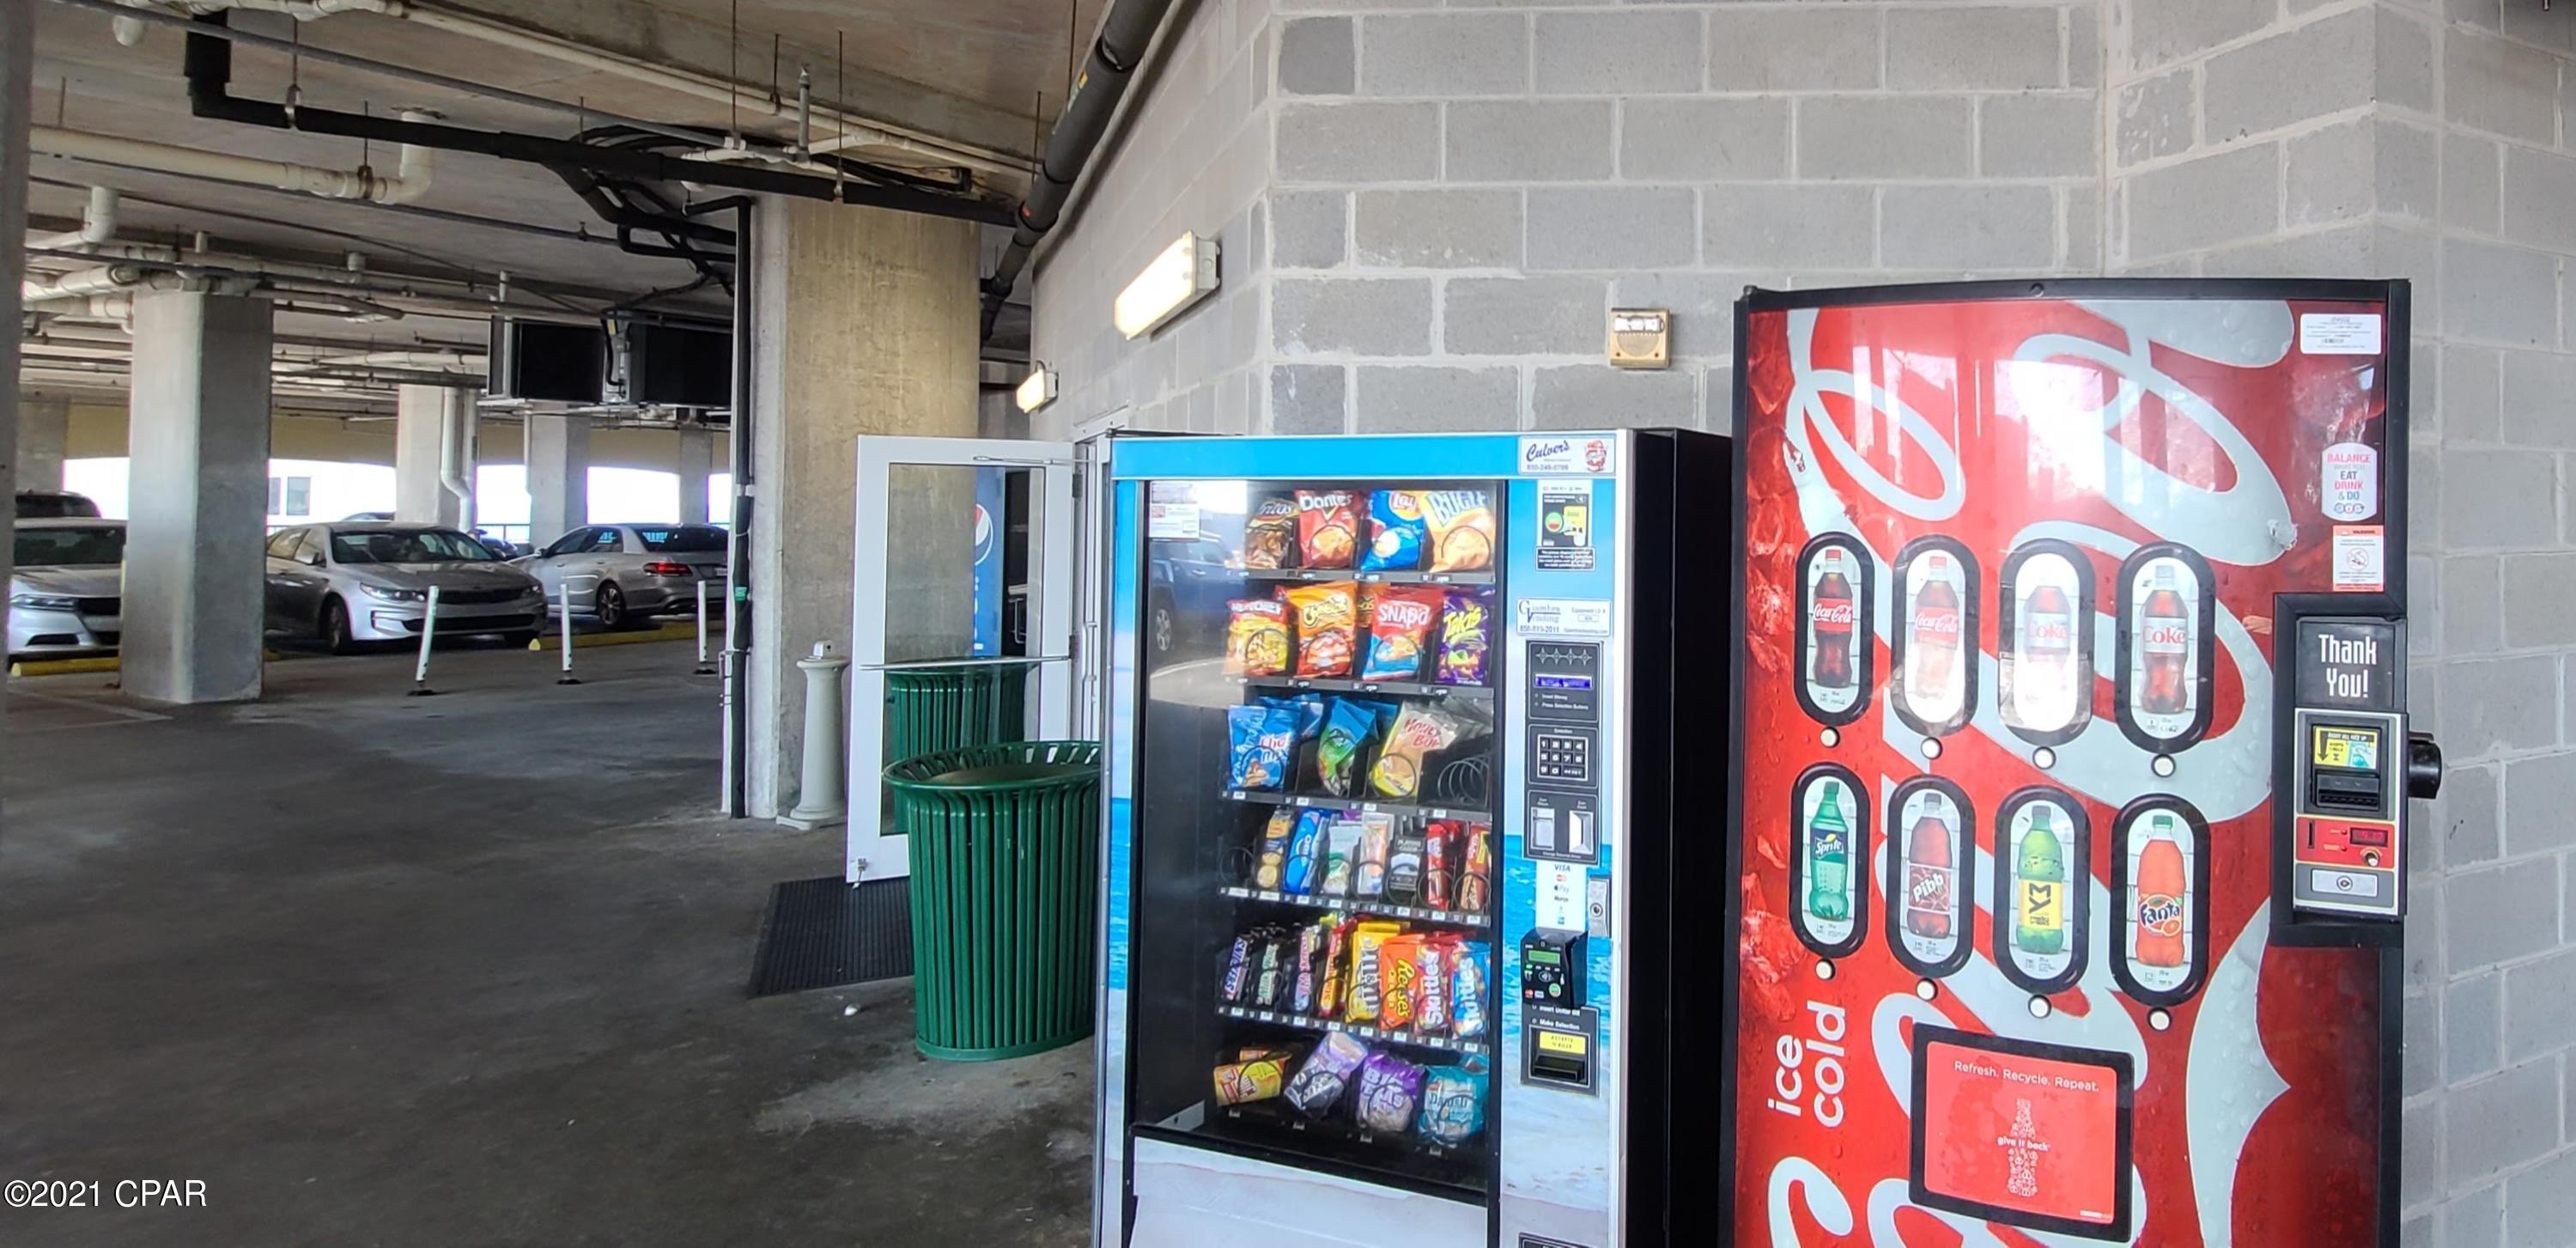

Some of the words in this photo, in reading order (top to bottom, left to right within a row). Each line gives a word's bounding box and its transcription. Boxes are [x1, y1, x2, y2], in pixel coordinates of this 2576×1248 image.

[2327, 453, 2372, 464] BALANCE
[2334, 481, 2364, 490] DRINK
[2340, 470, 2358, 481] EAT
[2347, 490, 2360, 501] DO
[2142, 625, 2186, 645] Coke
[2318, 634, 2377, 665] Thank
[2326, 667, 2368, 698] You!
[1815, 839, 1844, 856] Sprite
[1912, 872, 1945, 903] Pibb
[2140, 902, 2181, 926] Fanta
[1397, 958, 1415, 1018] Reese's
[1424, 950, 1443, 1025] Skittles
[1768, 1035, 1802, 1117] ice
[1806, 999, 1845, 1128] cold
[1953, 1060, 2000, 1079] Refresh.
[2002, 1068, 2051, 1087] Recycle.
[2055, 1075, 2099, 1093] Repeat.
[1997, 1136, 2017, 1148] give
[2018, 1138, 2026, 1148] it
[2026, 1139, 2049, 1151] back
